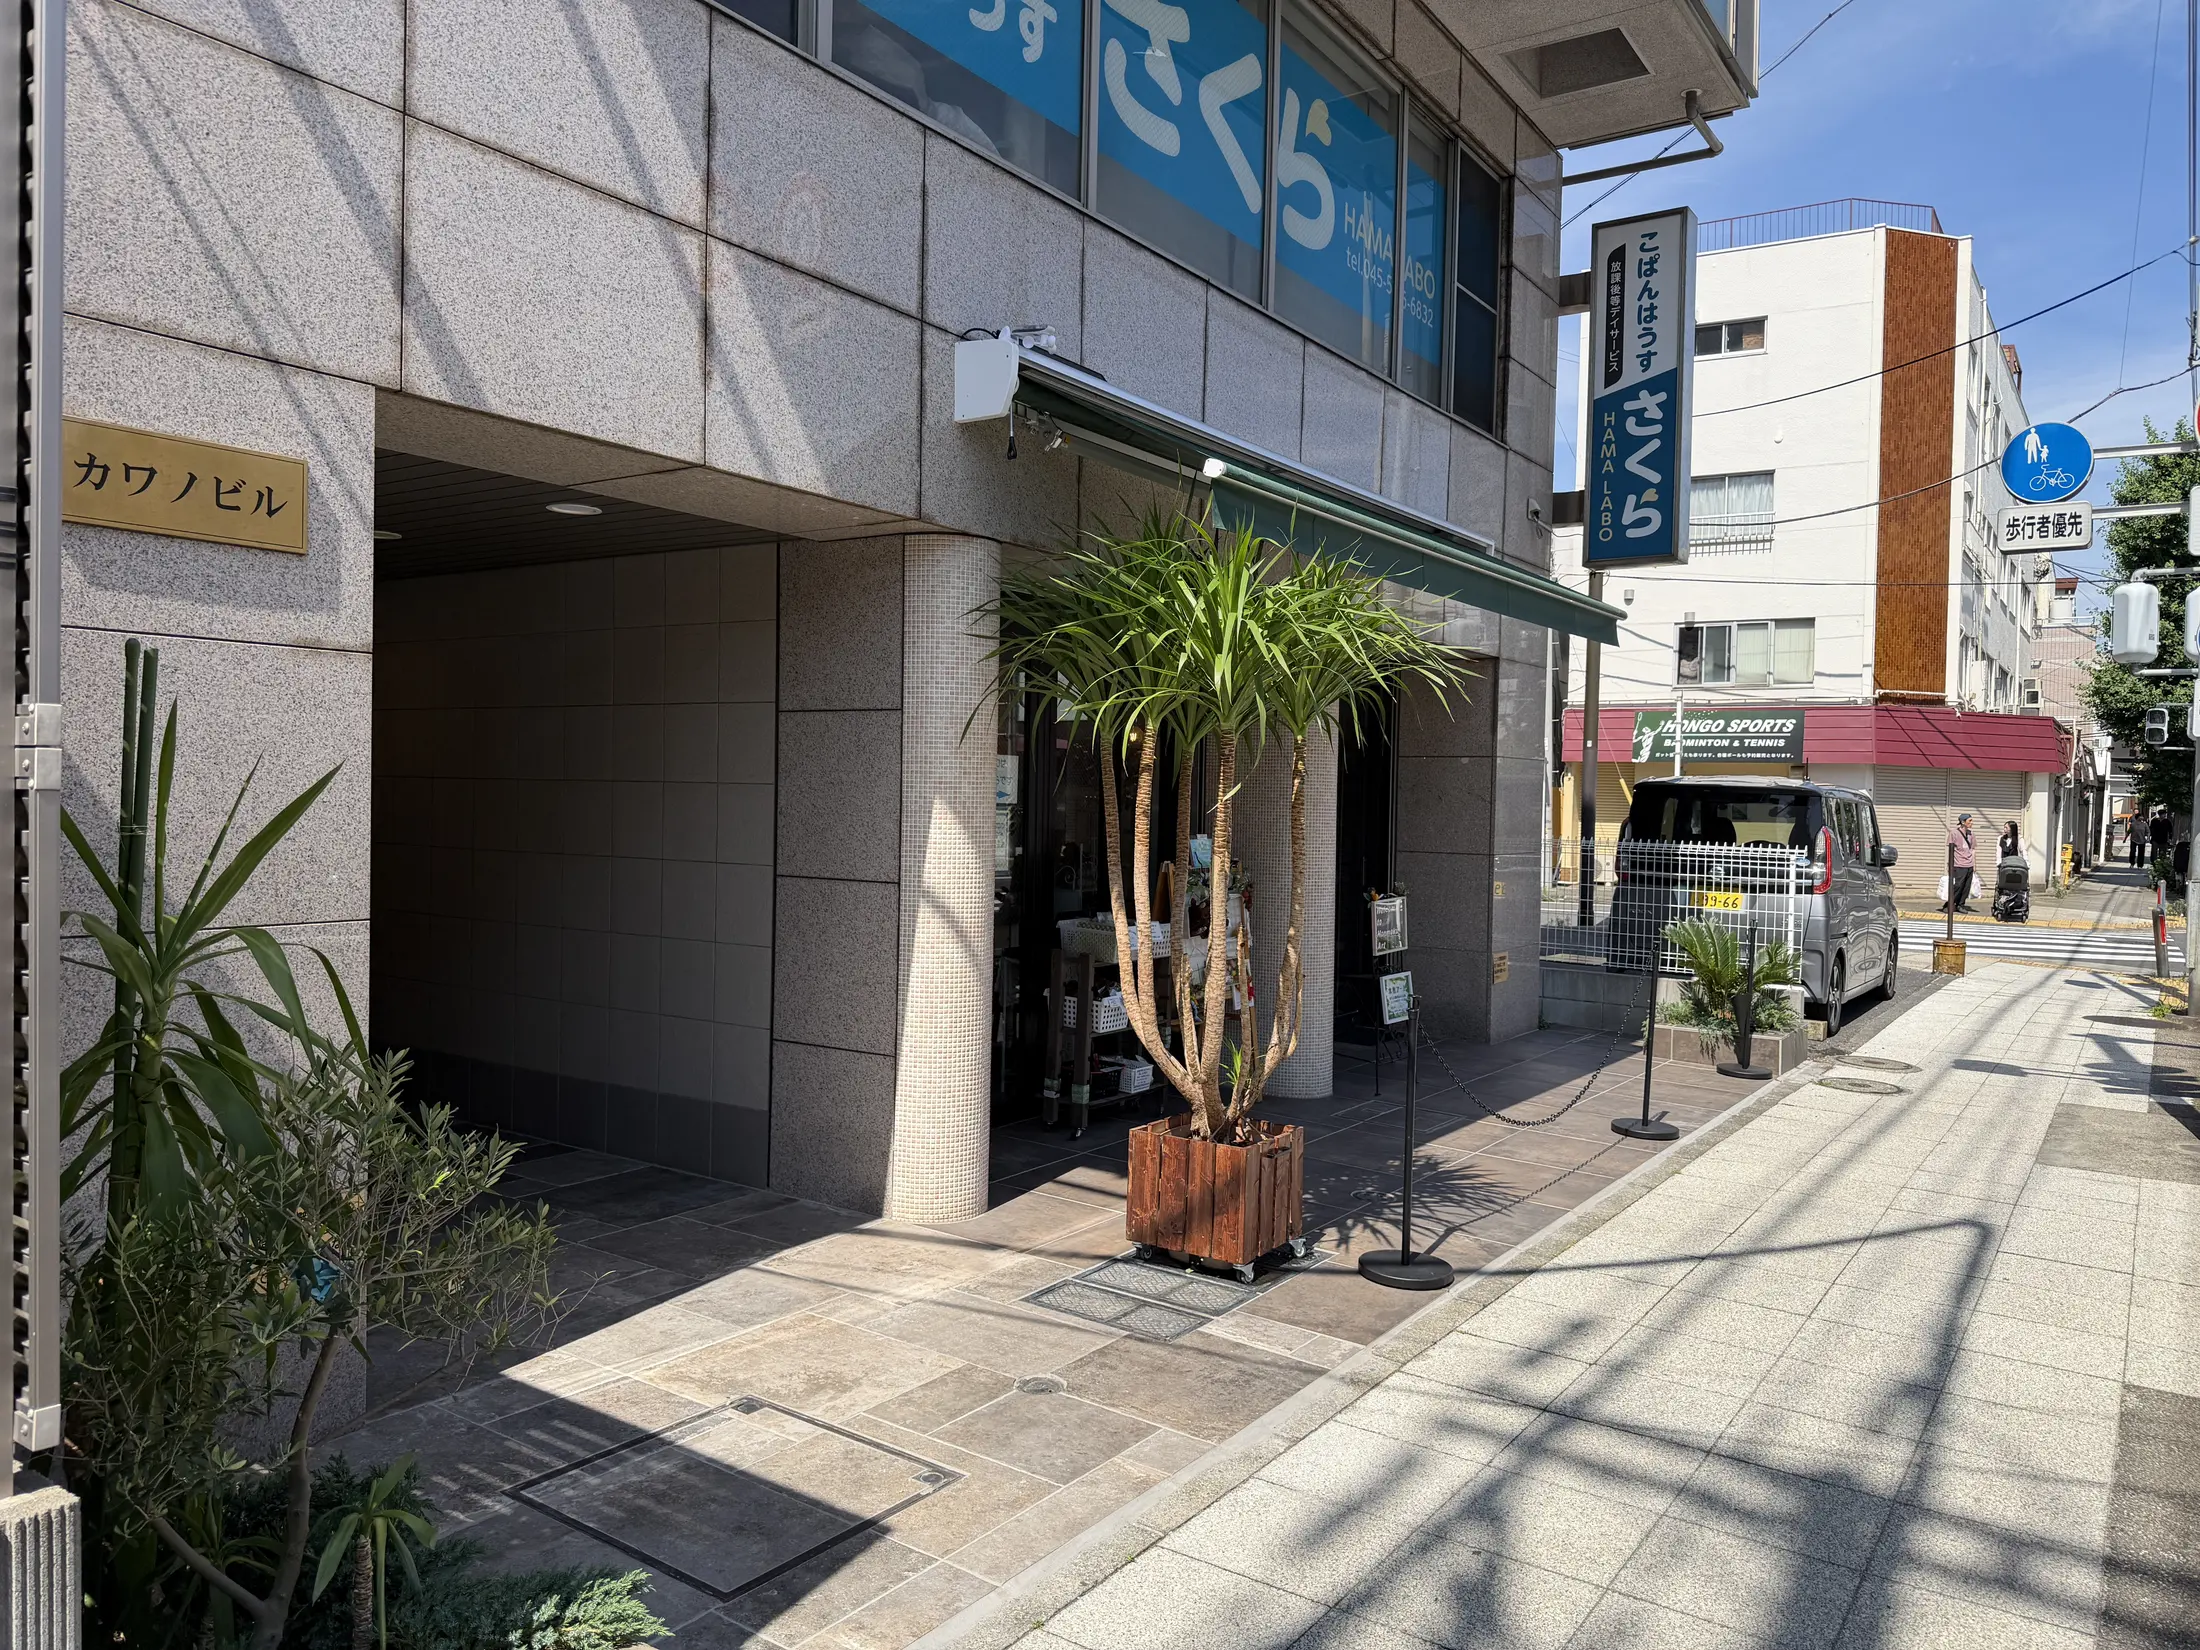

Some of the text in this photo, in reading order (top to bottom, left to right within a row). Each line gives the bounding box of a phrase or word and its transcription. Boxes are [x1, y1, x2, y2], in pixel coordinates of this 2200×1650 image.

[1105, 0, 1335, 250] さくら
[1344, 202, 1436, 299] HAMA ABO
[1346, 247, 1434, 328] tel.045-5-6832
[1608, 261, 1622, 373] 放課後等デイサービス
[1636, 231, 1662, 373] こぱんはうす
[73, 452, 288, 518] カワノビル
[1598, 412, 1617, 542] HAMA LABO
[1621, 389, 1668, 539] さくら
[2005, 511, 2083, 542] 歩行者優先
[1727, 718, 1797, 733] SPORTS
[1732, 739, 1741, 747] &
[1745, 738, 1786, 747] TENNIS
